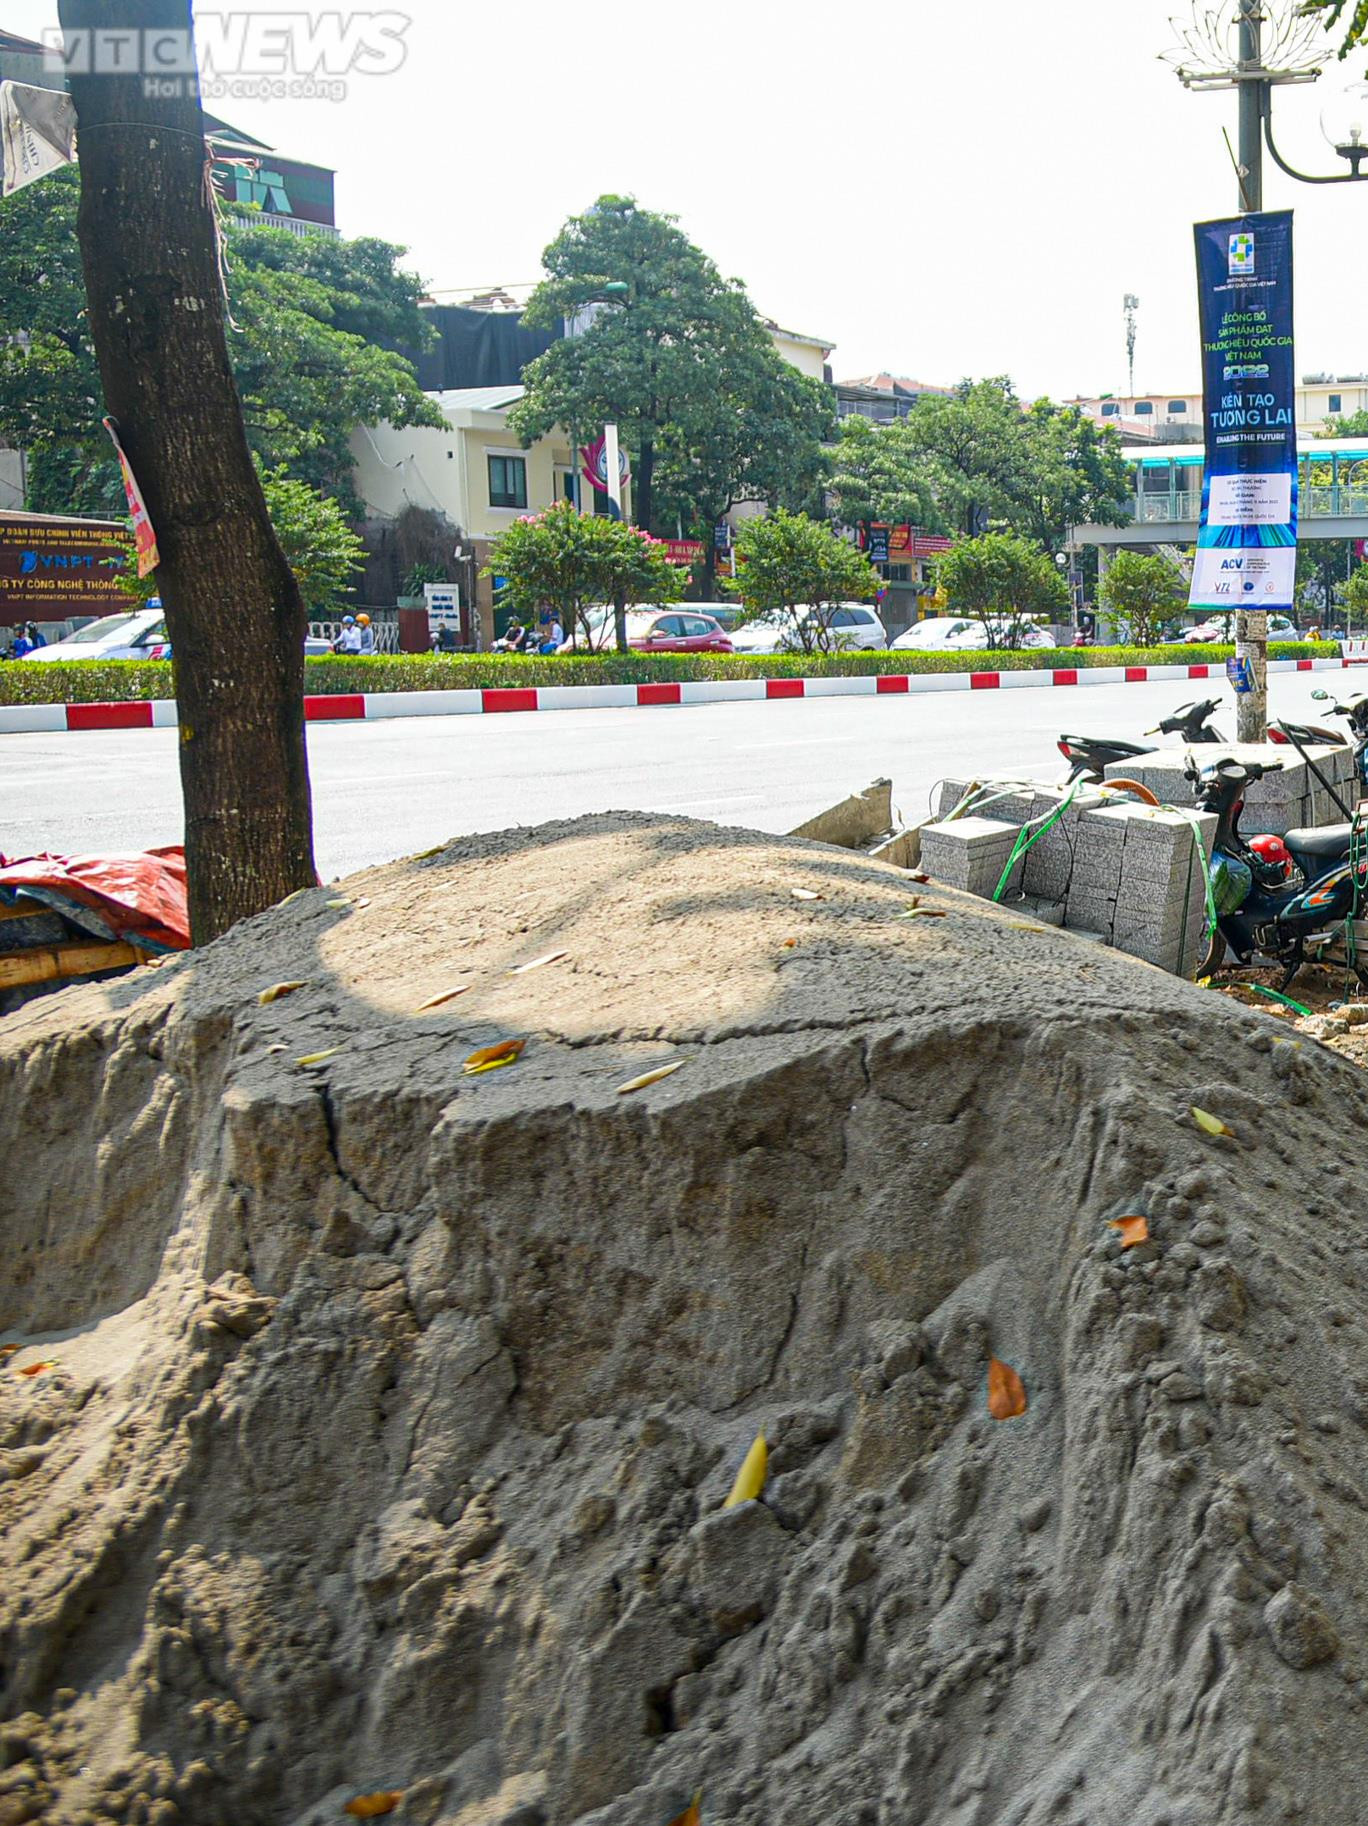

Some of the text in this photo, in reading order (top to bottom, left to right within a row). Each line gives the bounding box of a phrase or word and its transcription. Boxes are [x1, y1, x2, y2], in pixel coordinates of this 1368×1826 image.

[1253, 309, 1267, 321] BỐ
[1251, 335, 1277, 348] QUỐC
[1277, 336, 1293, 346] GIA
[1239, 350, 1262, 361] NAM
[1246, 393, 1275, 409] TẠO
[1210, 408, 1292, 428] TƯƠNG LAI
[1240, 433, 1256, 441] THE
[1256, 432, 1286, 441] FUTURE
[40, 554, 94, 569] VNPT
[1221, 558, 1244, 570] ACV
[11, 579, 23, 589] TY
[26, 577, 55, 590] CÔNG
[57, 577, 84, 591] NGHỆ
[86, 577, 118, 590] THÔNG
